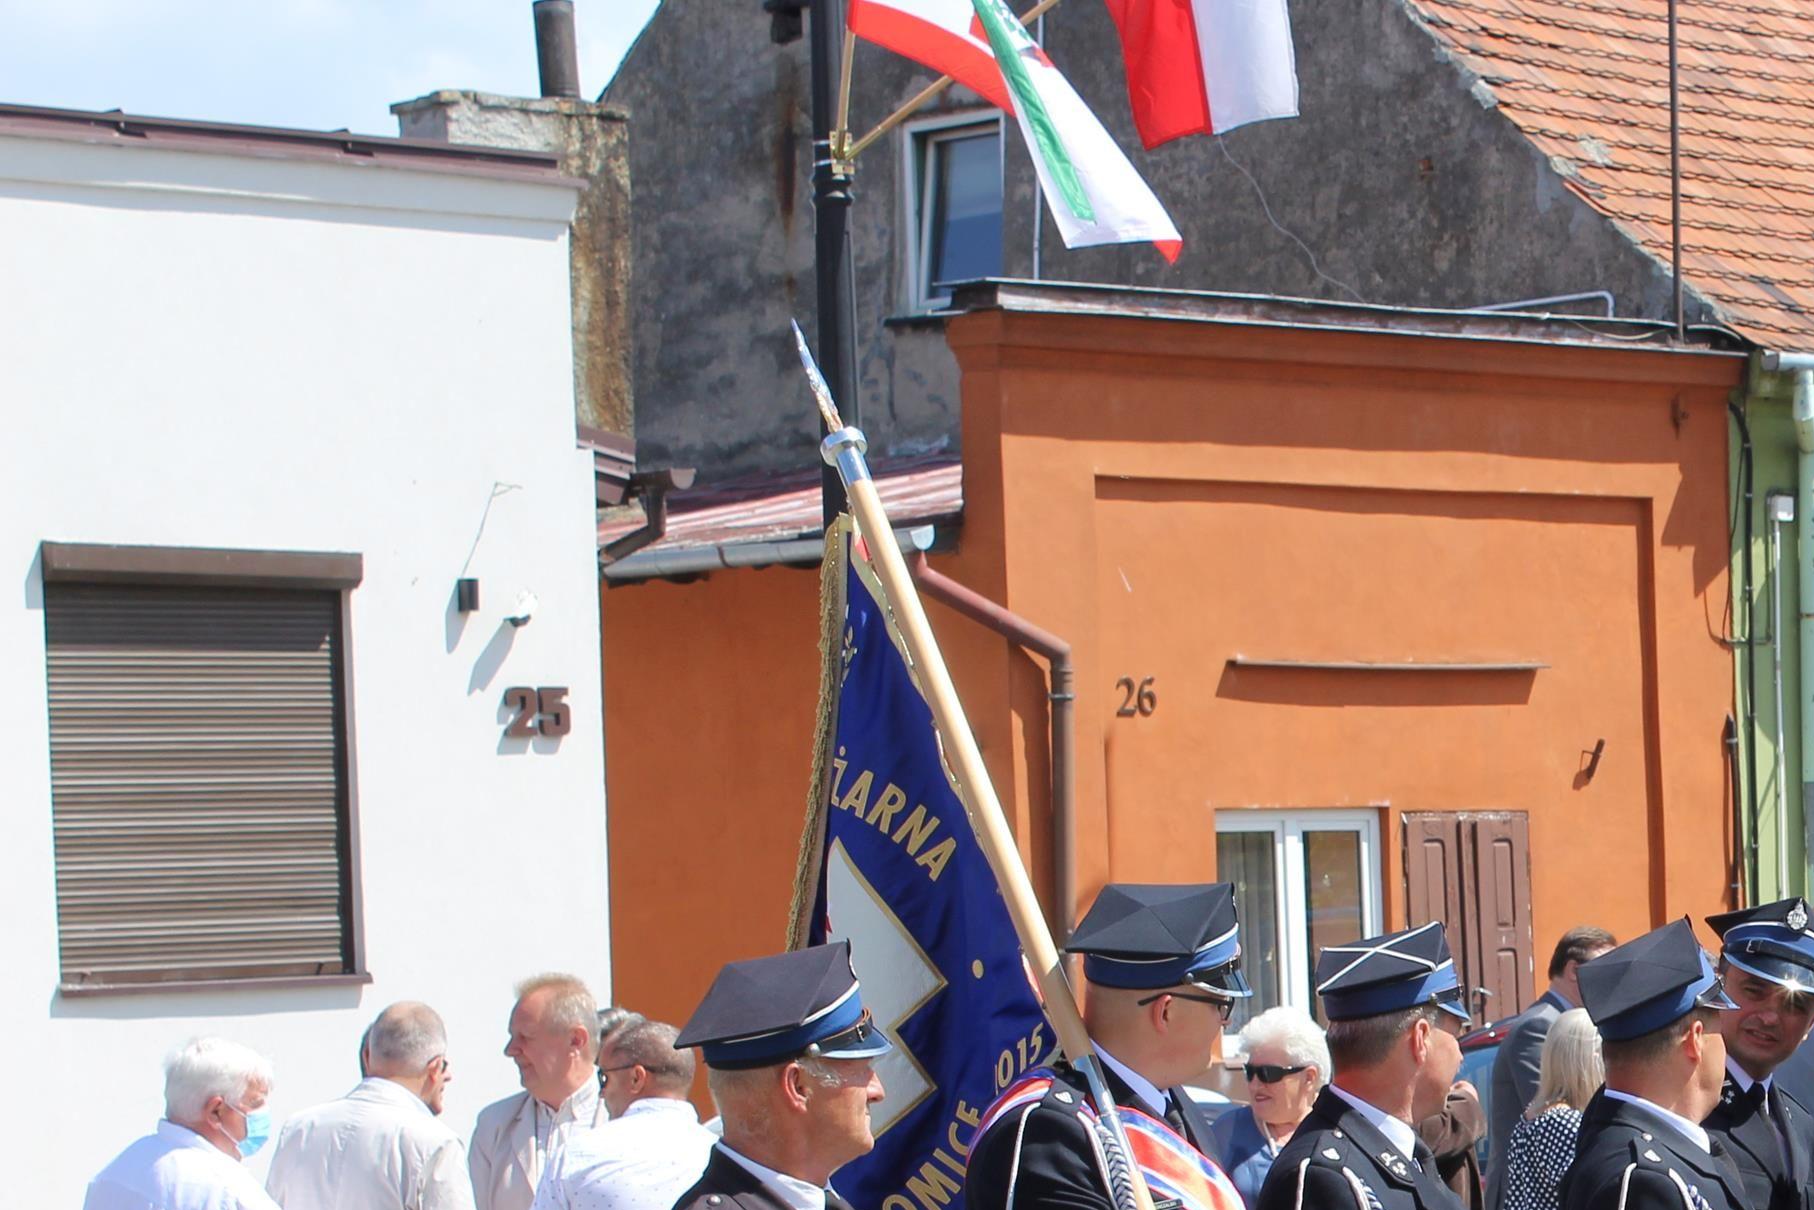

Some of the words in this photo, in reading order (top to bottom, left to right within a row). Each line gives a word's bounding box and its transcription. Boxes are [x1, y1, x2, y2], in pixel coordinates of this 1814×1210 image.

[503, 686, 571, 737] 25
[1115, 676, 1157, 718] 26
[995, 1022, 1044, 1096] 015
